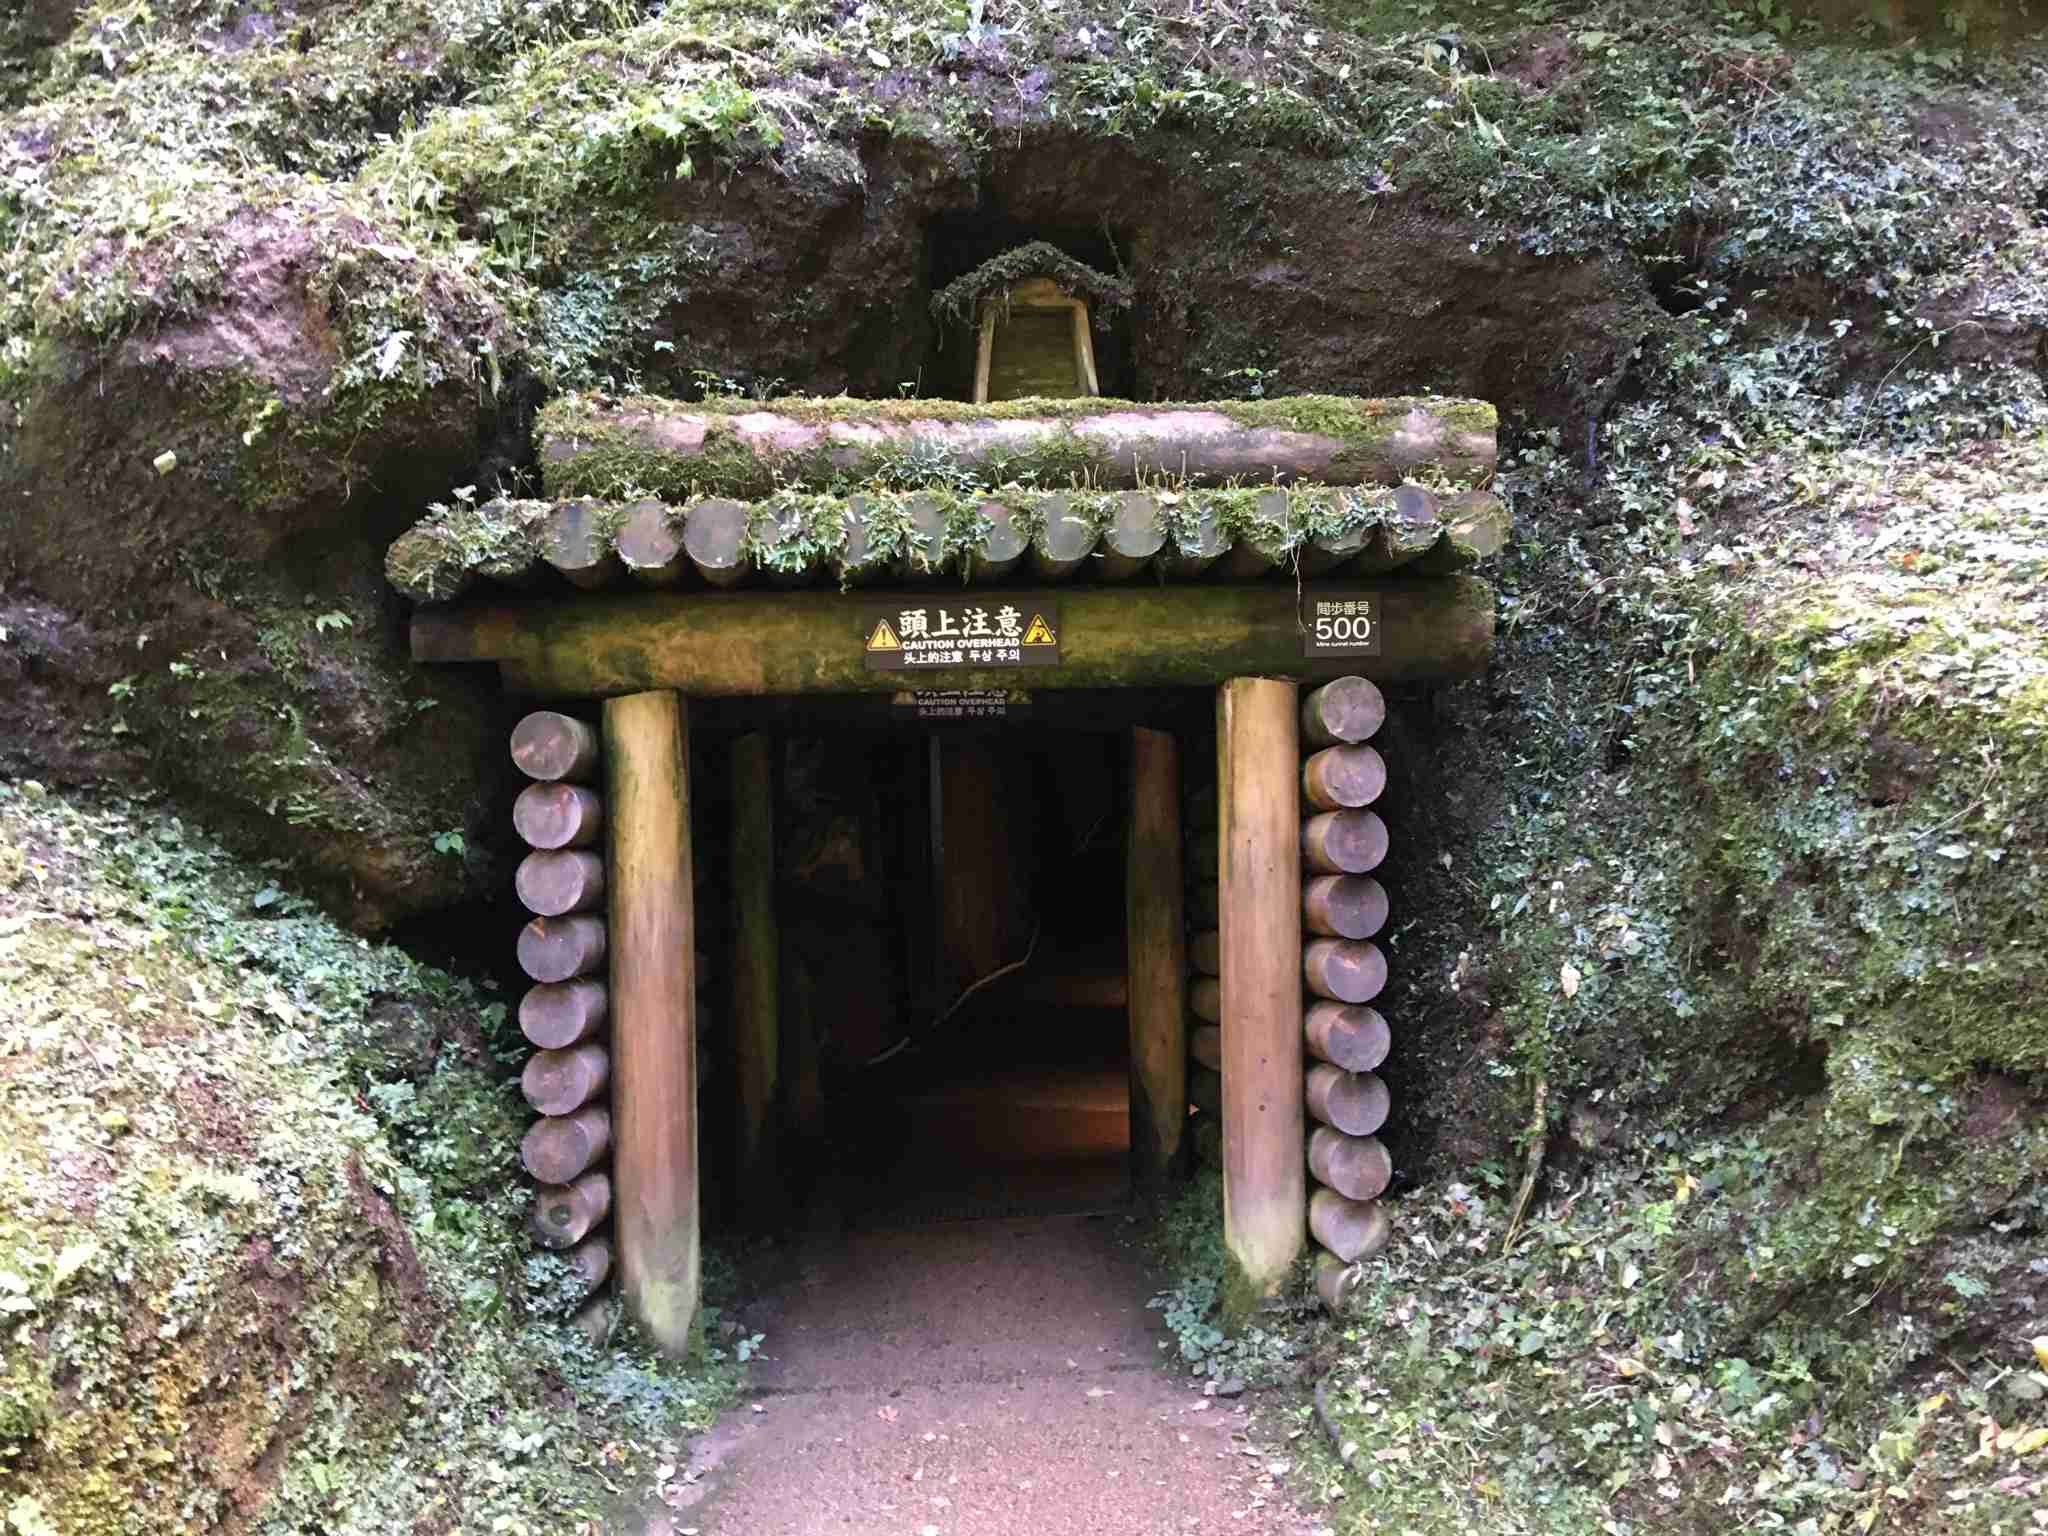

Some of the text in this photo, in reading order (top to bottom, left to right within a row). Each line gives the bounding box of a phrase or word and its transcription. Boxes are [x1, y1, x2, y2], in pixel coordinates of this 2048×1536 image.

[1316, 601, 1369, 616] 間歩番号
[898, 605, 1024, 638] 頭上注意
[1316, 617, 1371, 640] 500
[902, 638, 1020, 651] CAUTION OVERHEAD
[903, 650, 964, 664] 头上的注意
[969, 649, 1020, 662] 두상 주의
[918, 698, 957, 706] CAUTION
